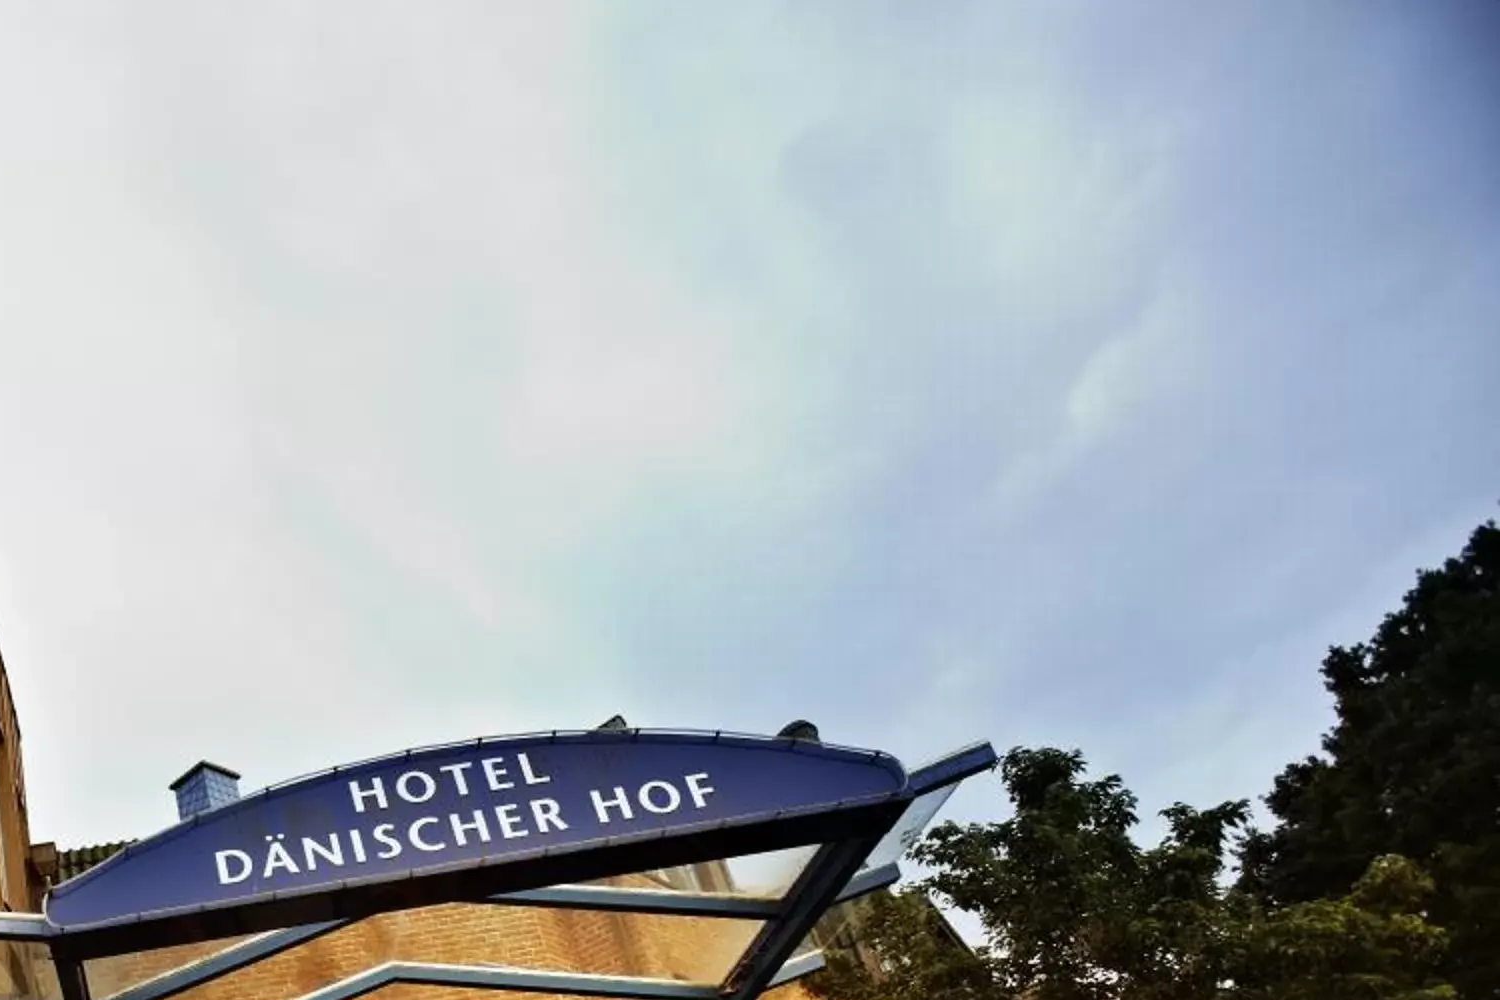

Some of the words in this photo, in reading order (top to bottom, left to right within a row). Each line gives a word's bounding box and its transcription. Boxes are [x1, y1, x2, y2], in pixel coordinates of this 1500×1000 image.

[348, 753, 552, 813] HOTEL
[214, 797, 569, 886] DÄNISCHER
[589, 772, 715, 823] HOF
